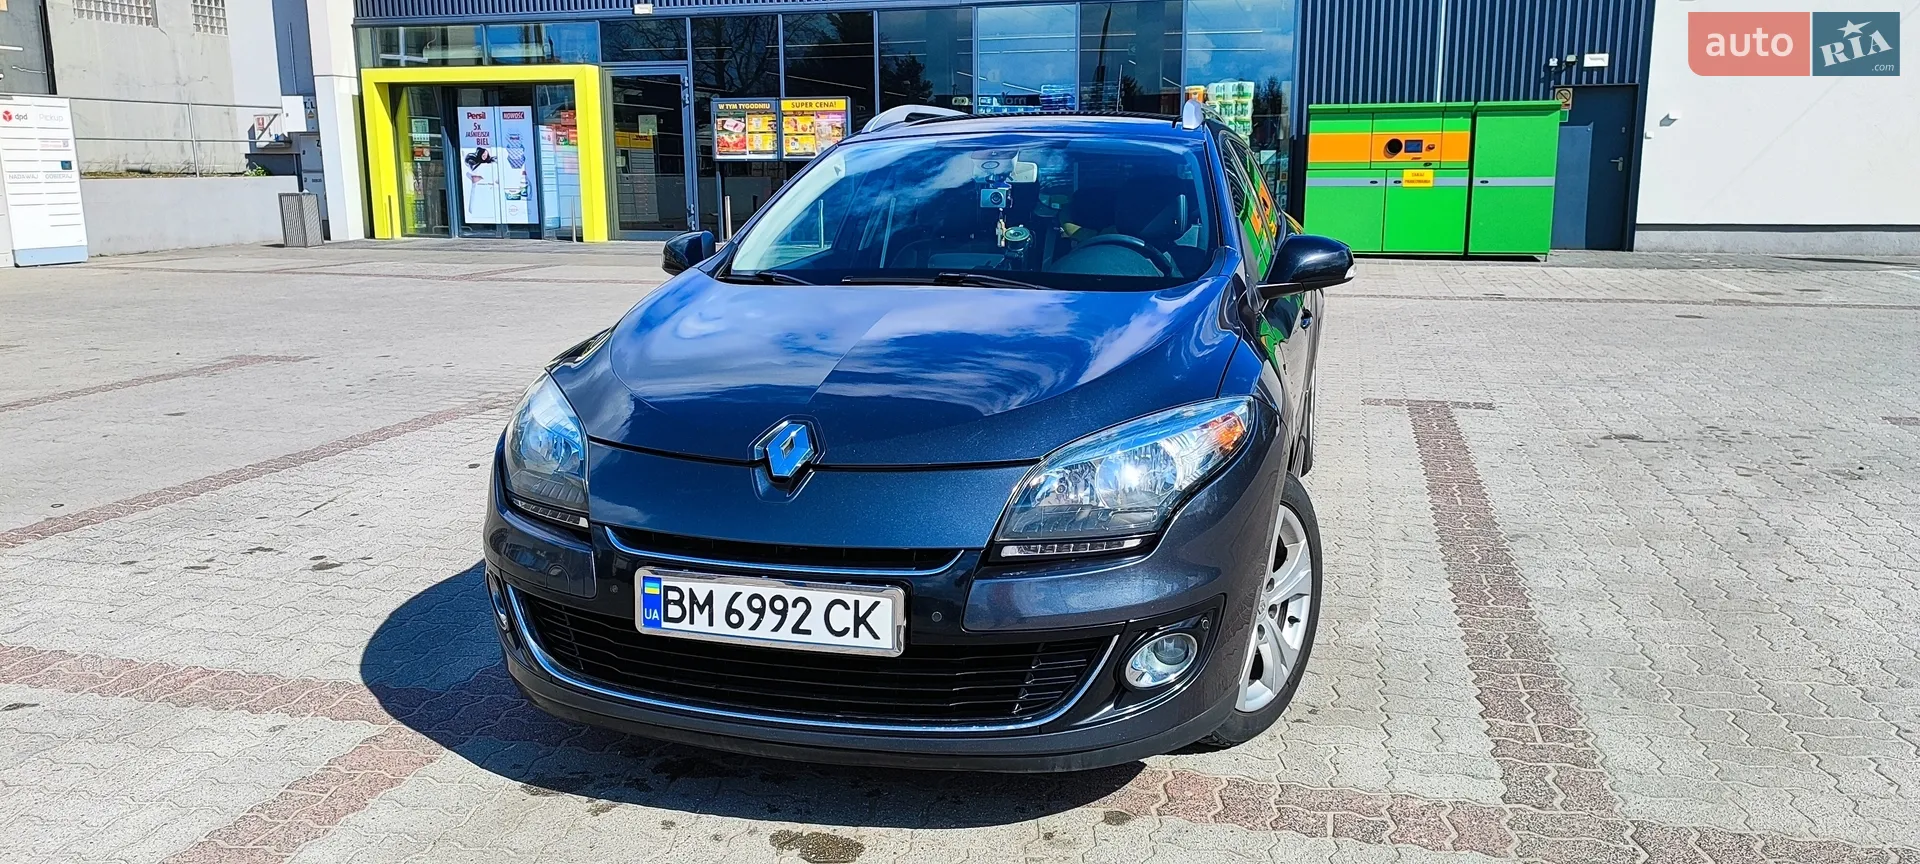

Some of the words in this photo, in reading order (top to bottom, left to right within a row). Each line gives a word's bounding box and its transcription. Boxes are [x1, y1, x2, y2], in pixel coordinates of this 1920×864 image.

[791, 101, 814, 109] SUPER
[39, 114, 63, 122] Pickup
[474, 122, 481, 130] 5x
[476, 138, 490, 146] BIEL
[644, 607, 660, 621] UA
[662, 585, 714, 627] BM
[724, 591, 812, 636] 6992
[823, 599, 881, 640] CK
